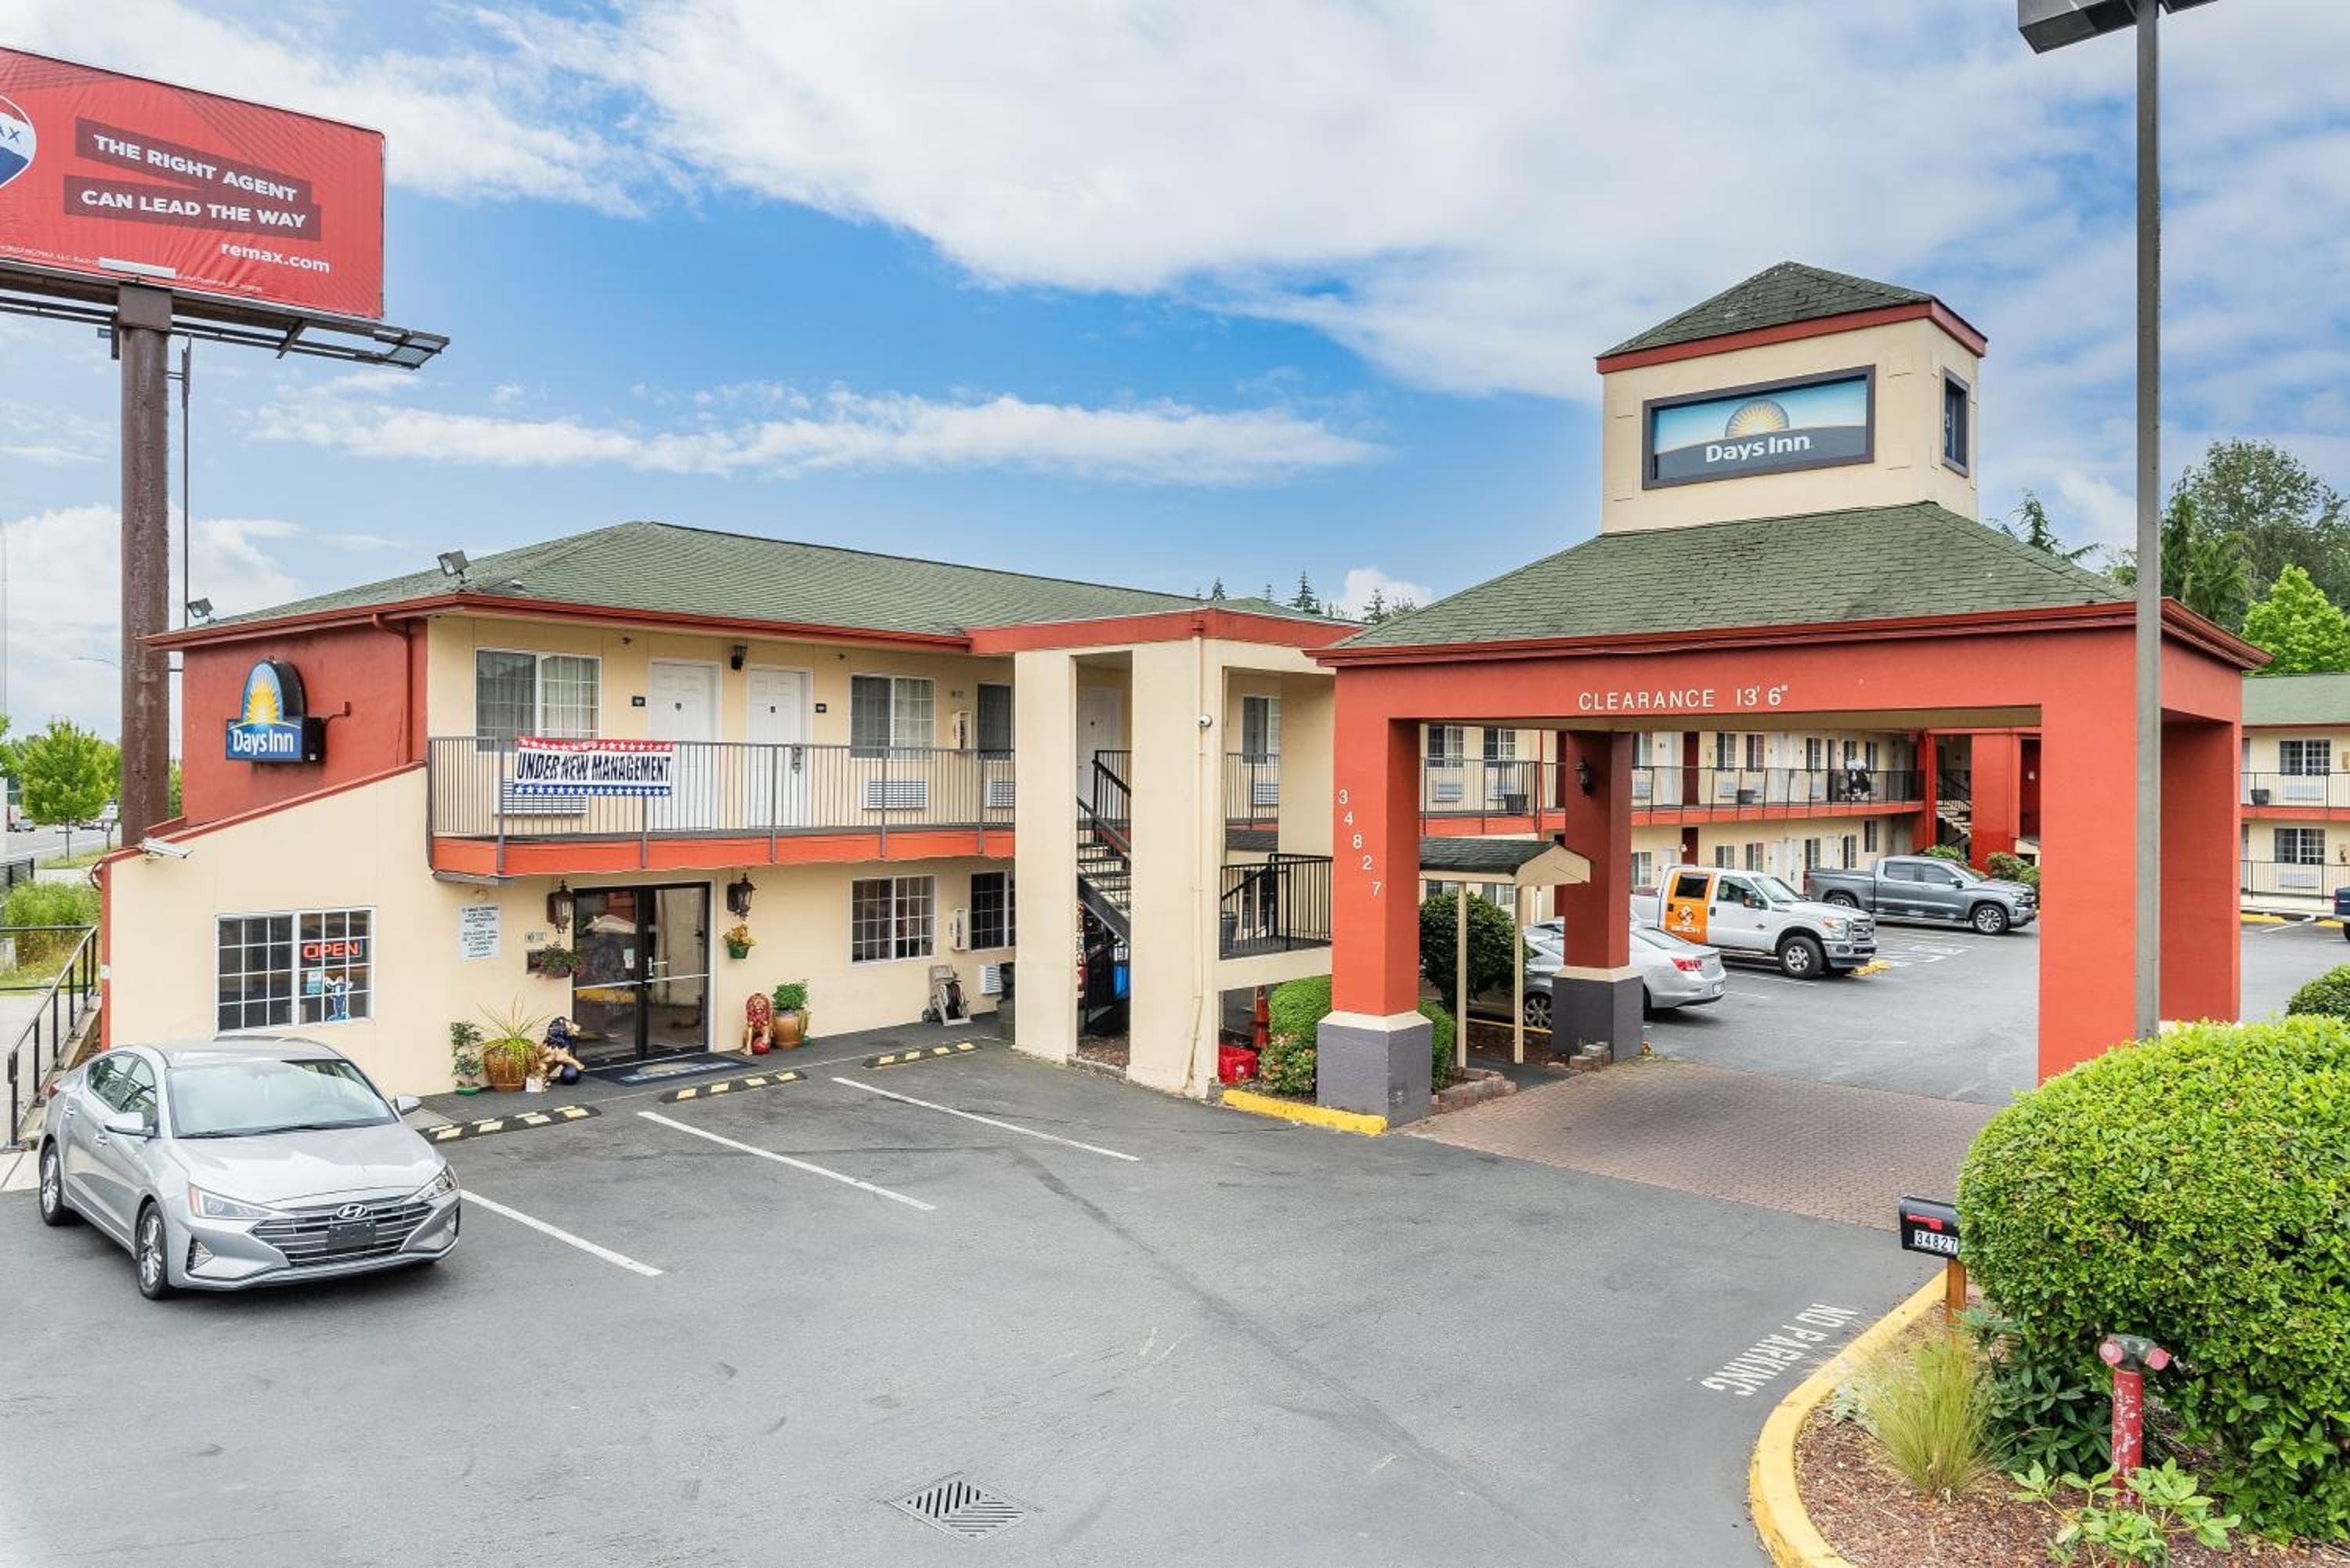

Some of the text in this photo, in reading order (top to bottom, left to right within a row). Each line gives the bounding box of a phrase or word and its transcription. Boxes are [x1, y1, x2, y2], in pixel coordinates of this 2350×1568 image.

[93, 134, 297, 202] THE RIGHT AGENT
[81, 190, 306, 228] CAN LEAD THE WAY
[221, 242, 330, 273] remax.com
[1705, 435, 1810, 463] Days Inn
[1578, 689, 1716, 710] CLEARANCE
[1736, 685, 1760, 706] 13'
[233, 728, 294, 756] Days Inn
[516, 752, 671, 782] UNDER NEW MANAGEMENT
[303, 942, 359, 958] OPEN
[1917, 1232, 1957, 1252] 34827
[1700, 1302, 1860, 1396] NO PARKING
